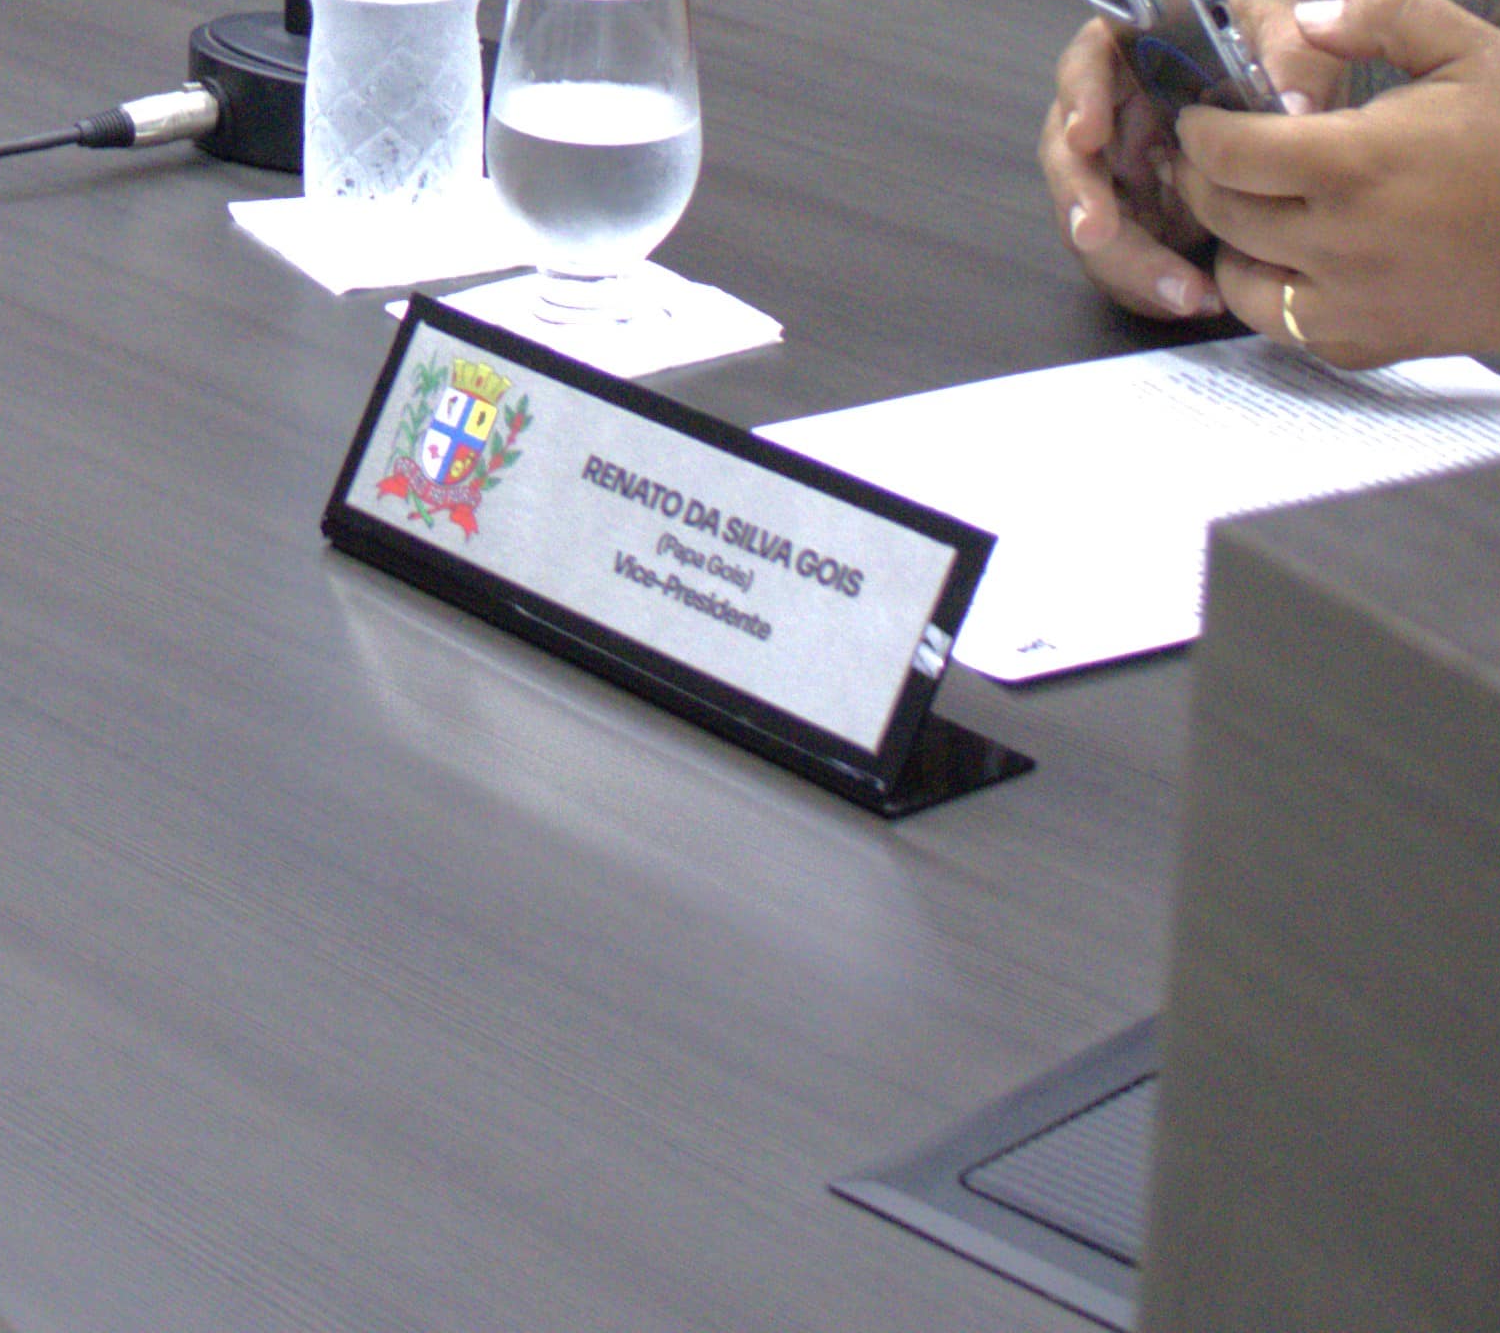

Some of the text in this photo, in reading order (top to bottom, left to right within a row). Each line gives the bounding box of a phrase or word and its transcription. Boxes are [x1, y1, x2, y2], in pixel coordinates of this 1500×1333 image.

[581, 454, 864, 597] RENATO DA SILVA GOIS
[656, 532, 755, 593] (Papa Gois)
[614, 550, 773, 641] Vice-Presidente
